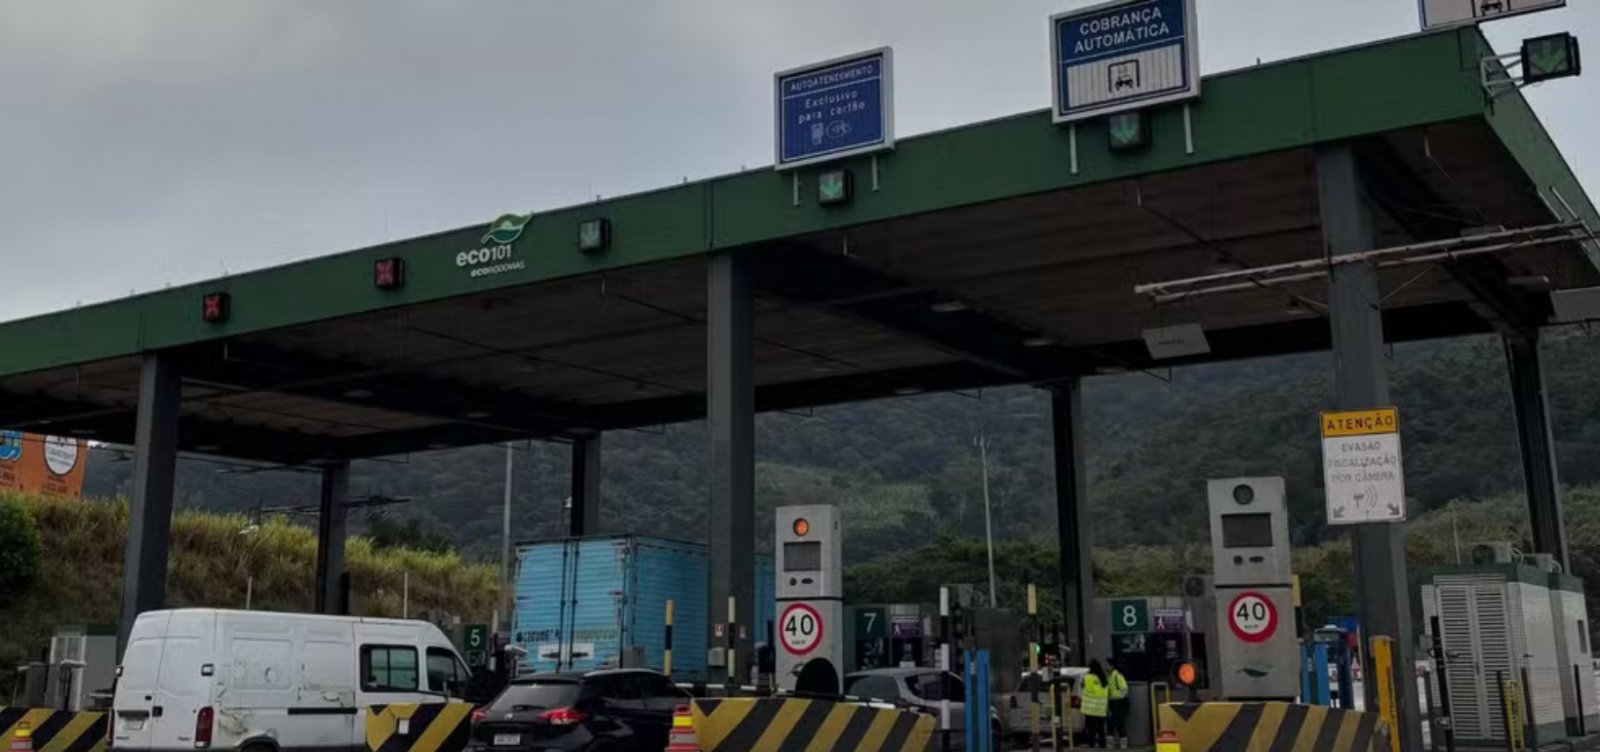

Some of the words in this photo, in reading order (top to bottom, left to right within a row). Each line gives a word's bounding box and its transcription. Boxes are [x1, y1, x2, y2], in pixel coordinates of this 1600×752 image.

[1079, 6, 1162, 35] COBRANÇA
[1074, 21, 1169, 53] AUTOMÁTICA
[791, 65, 873, 91] AUTOATENDIMENTO
[805, 91, 858, 109] Exclusivo
[798, 111, 822, 125] para
[830, 102, 865, 117] cartão
[456, 245, 511, 267] eco101
[1327, 413, 1392, 430] ATENÇÃO
[864, 612, 876, 633] 7
[1123, 604, 1137, 627] 8
[1236, 602, 1265, 621] 40
[785, 614, 814, 636] 40
[470, 628, 480, 647] 5
